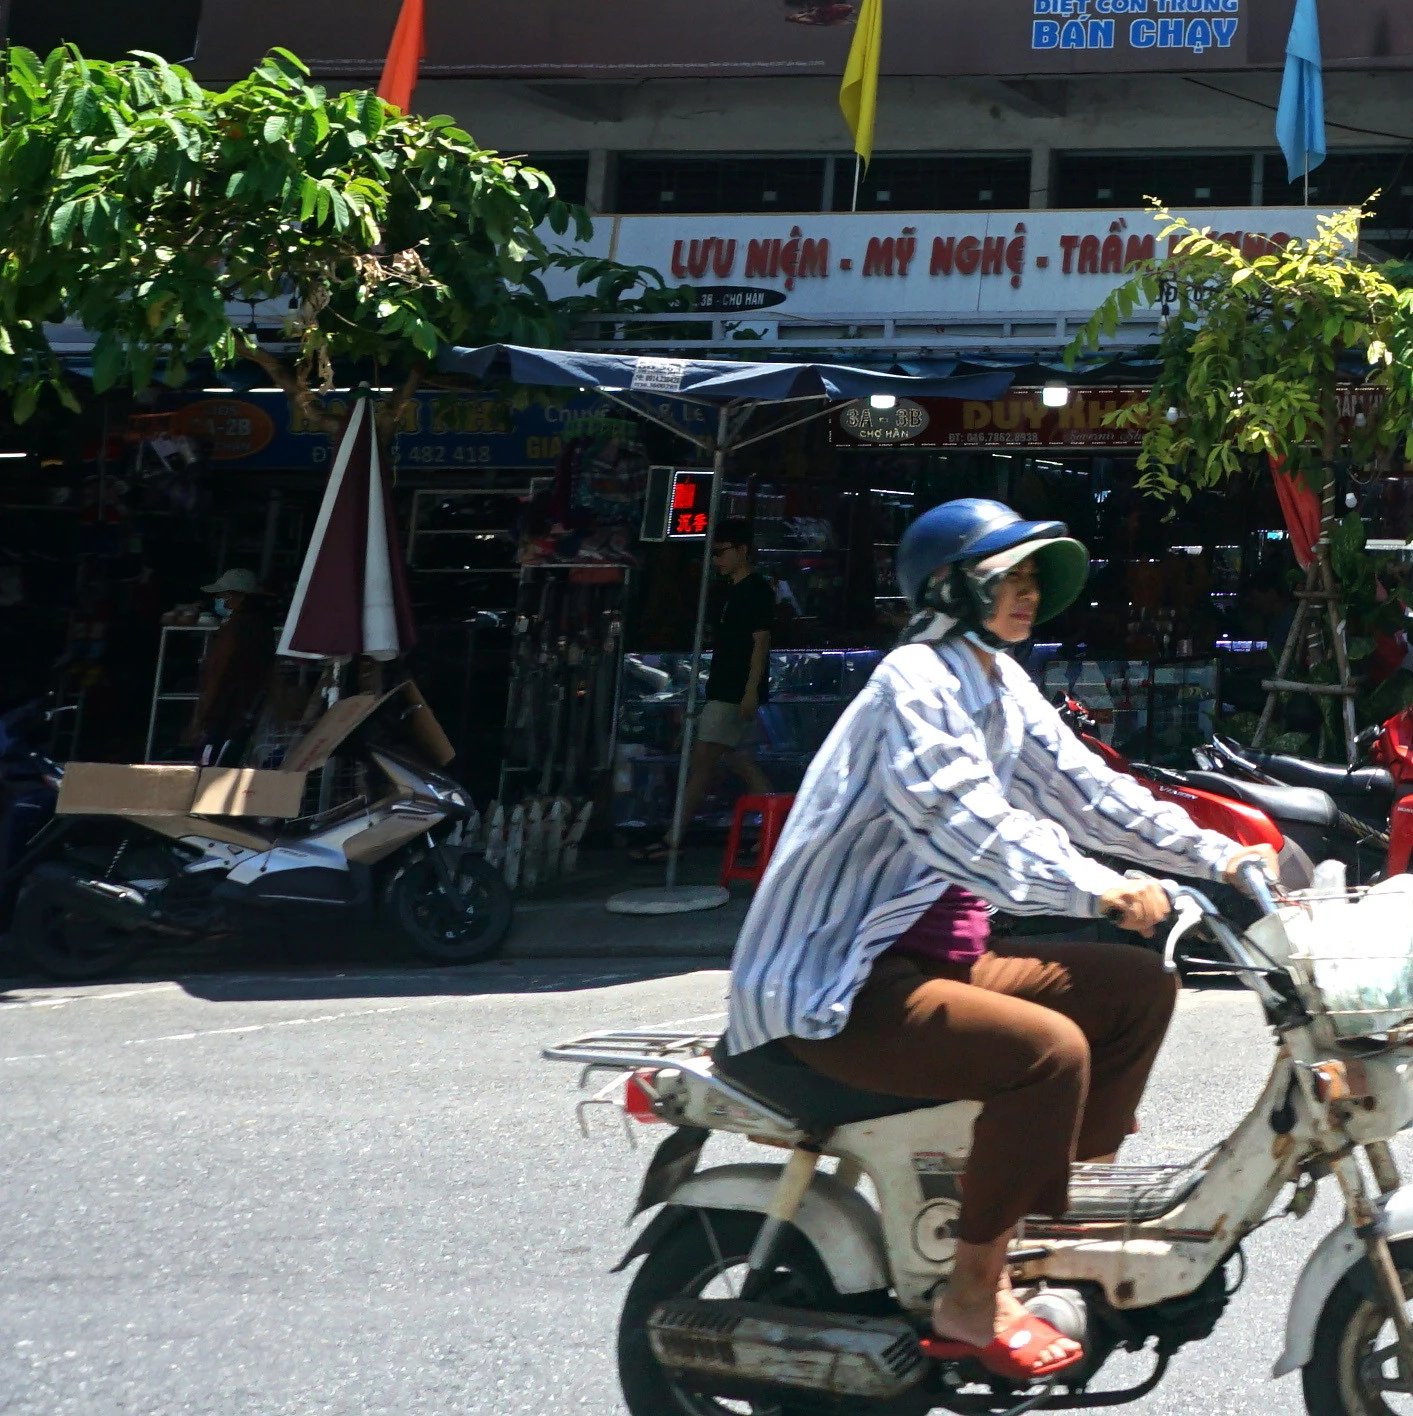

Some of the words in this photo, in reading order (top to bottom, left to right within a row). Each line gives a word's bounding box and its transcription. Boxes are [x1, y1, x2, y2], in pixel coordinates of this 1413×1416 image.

[1031, 14, 1115, 49] BÁN
[1129, 18, 1239, 53] CHẠY
[670, 236, 737, 279] LƯU
[744, 224, 830, 292] NIỆM
[861, 227, 917, 276] MỸ
[929, 222, 1027, 289] NGHỆ
[1060, 217, 1156, 275] TRẦM
[962, 400, 1050, 430] DUY
[408, 445, 447, 463] 482
[453, 445, 492, 463] 418
